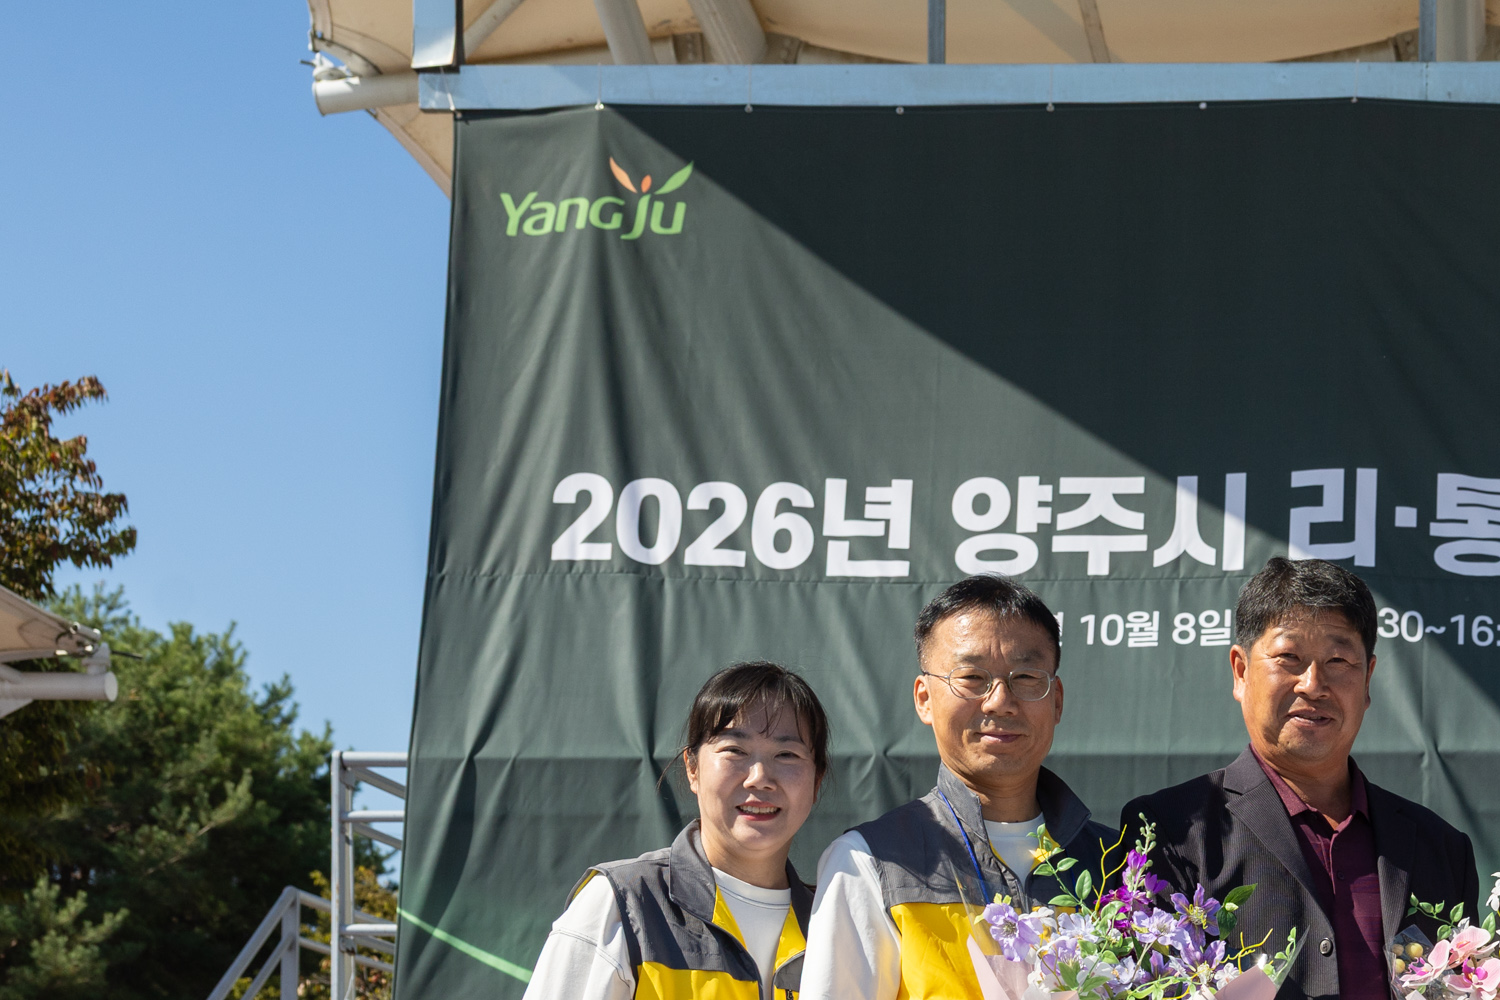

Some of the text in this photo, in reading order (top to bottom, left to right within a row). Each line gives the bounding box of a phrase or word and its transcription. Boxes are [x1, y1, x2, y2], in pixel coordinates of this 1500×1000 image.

[551, 472, 914, 577] 2026년
[951, 472, 1248, 576] 양주시
[1080, 610, 1160, 648] 10월
[1171, 608, 1233, 647] 8일
